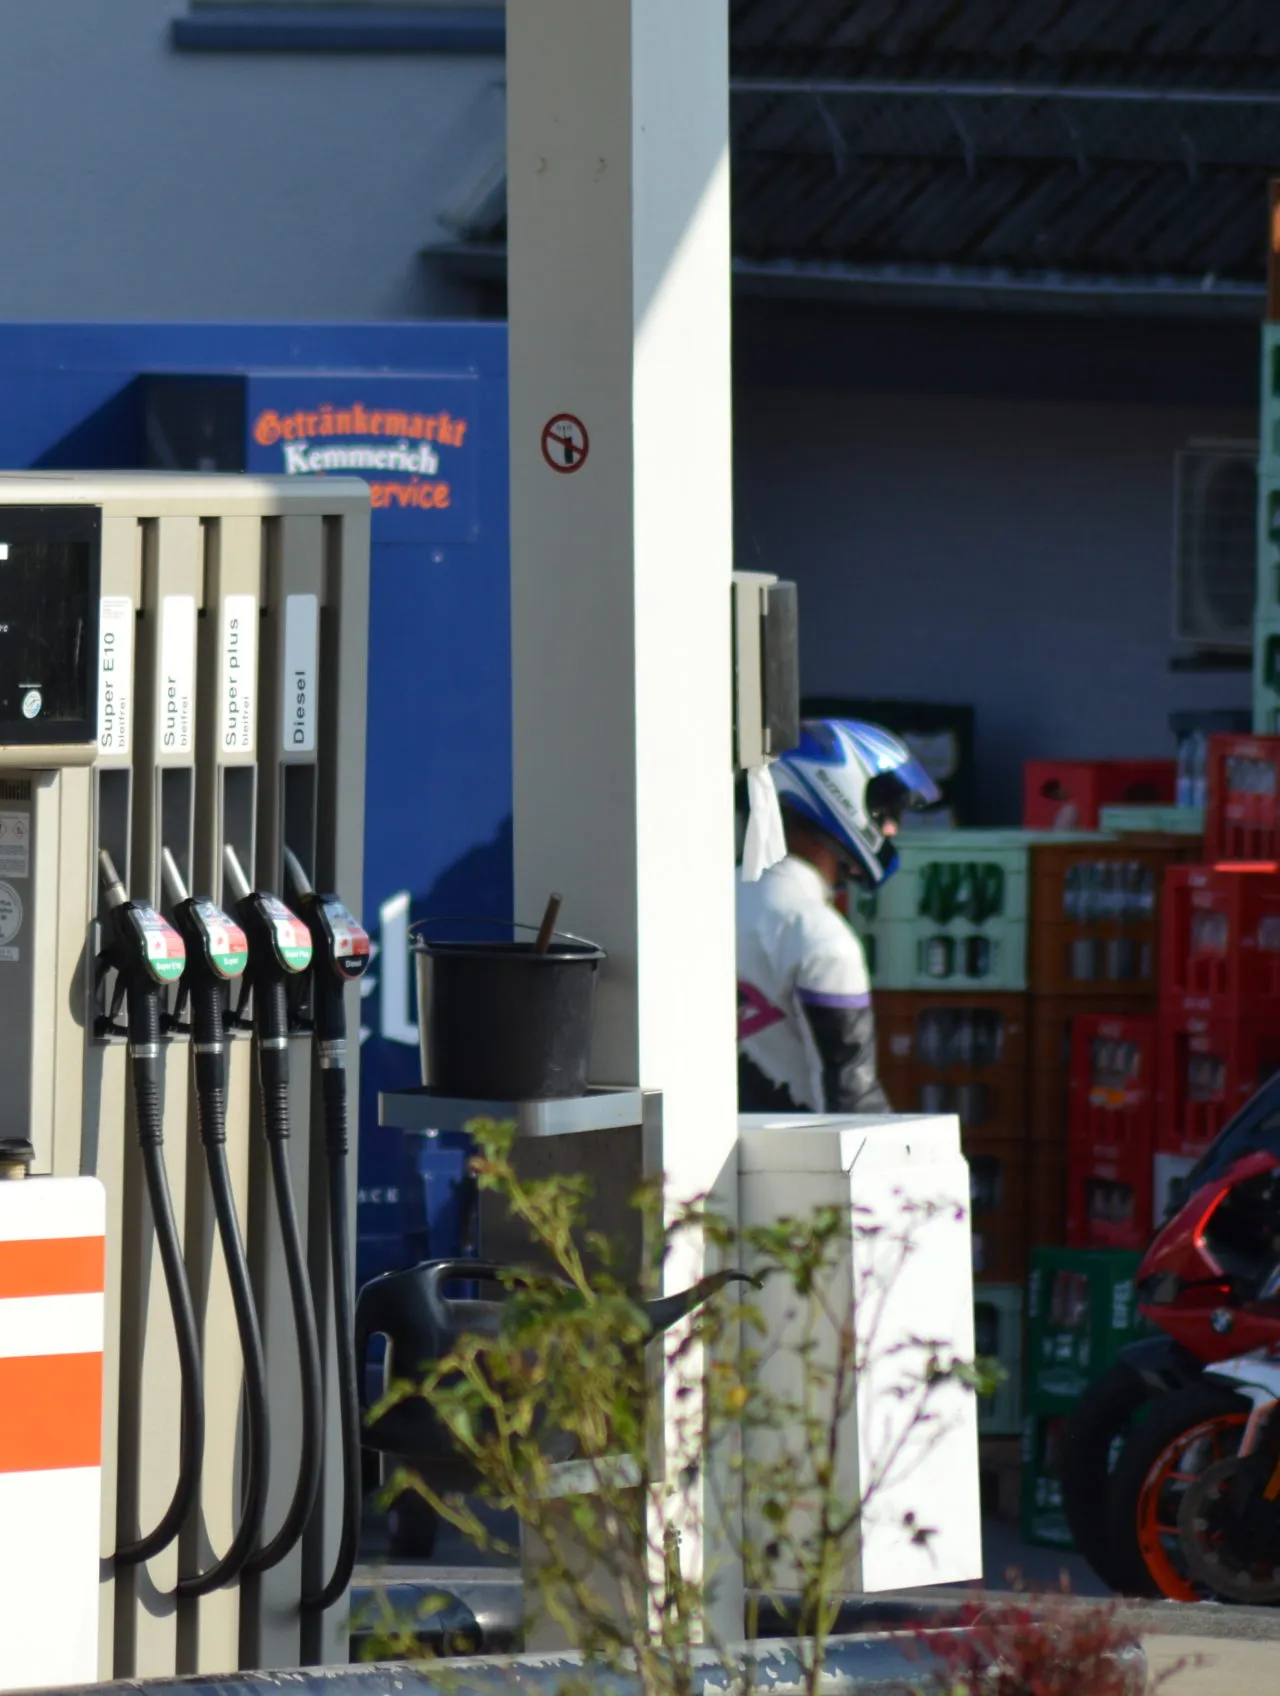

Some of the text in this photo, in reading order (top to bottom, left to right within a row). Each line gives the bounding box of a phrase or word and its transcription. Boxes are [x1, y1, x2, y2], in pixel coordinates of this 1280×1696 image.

[253, 402, 468, 448] Getränkemarkt
[283, 440, 440, 476] Kemmerich
[370, 476, 451, 509] ervice
[101, 631, 115, 747] Super E10
[164, 676, 177, 747] Super
[225, 618, 241, 746] Super plus
[293, 670, 306, 744] Diesel
